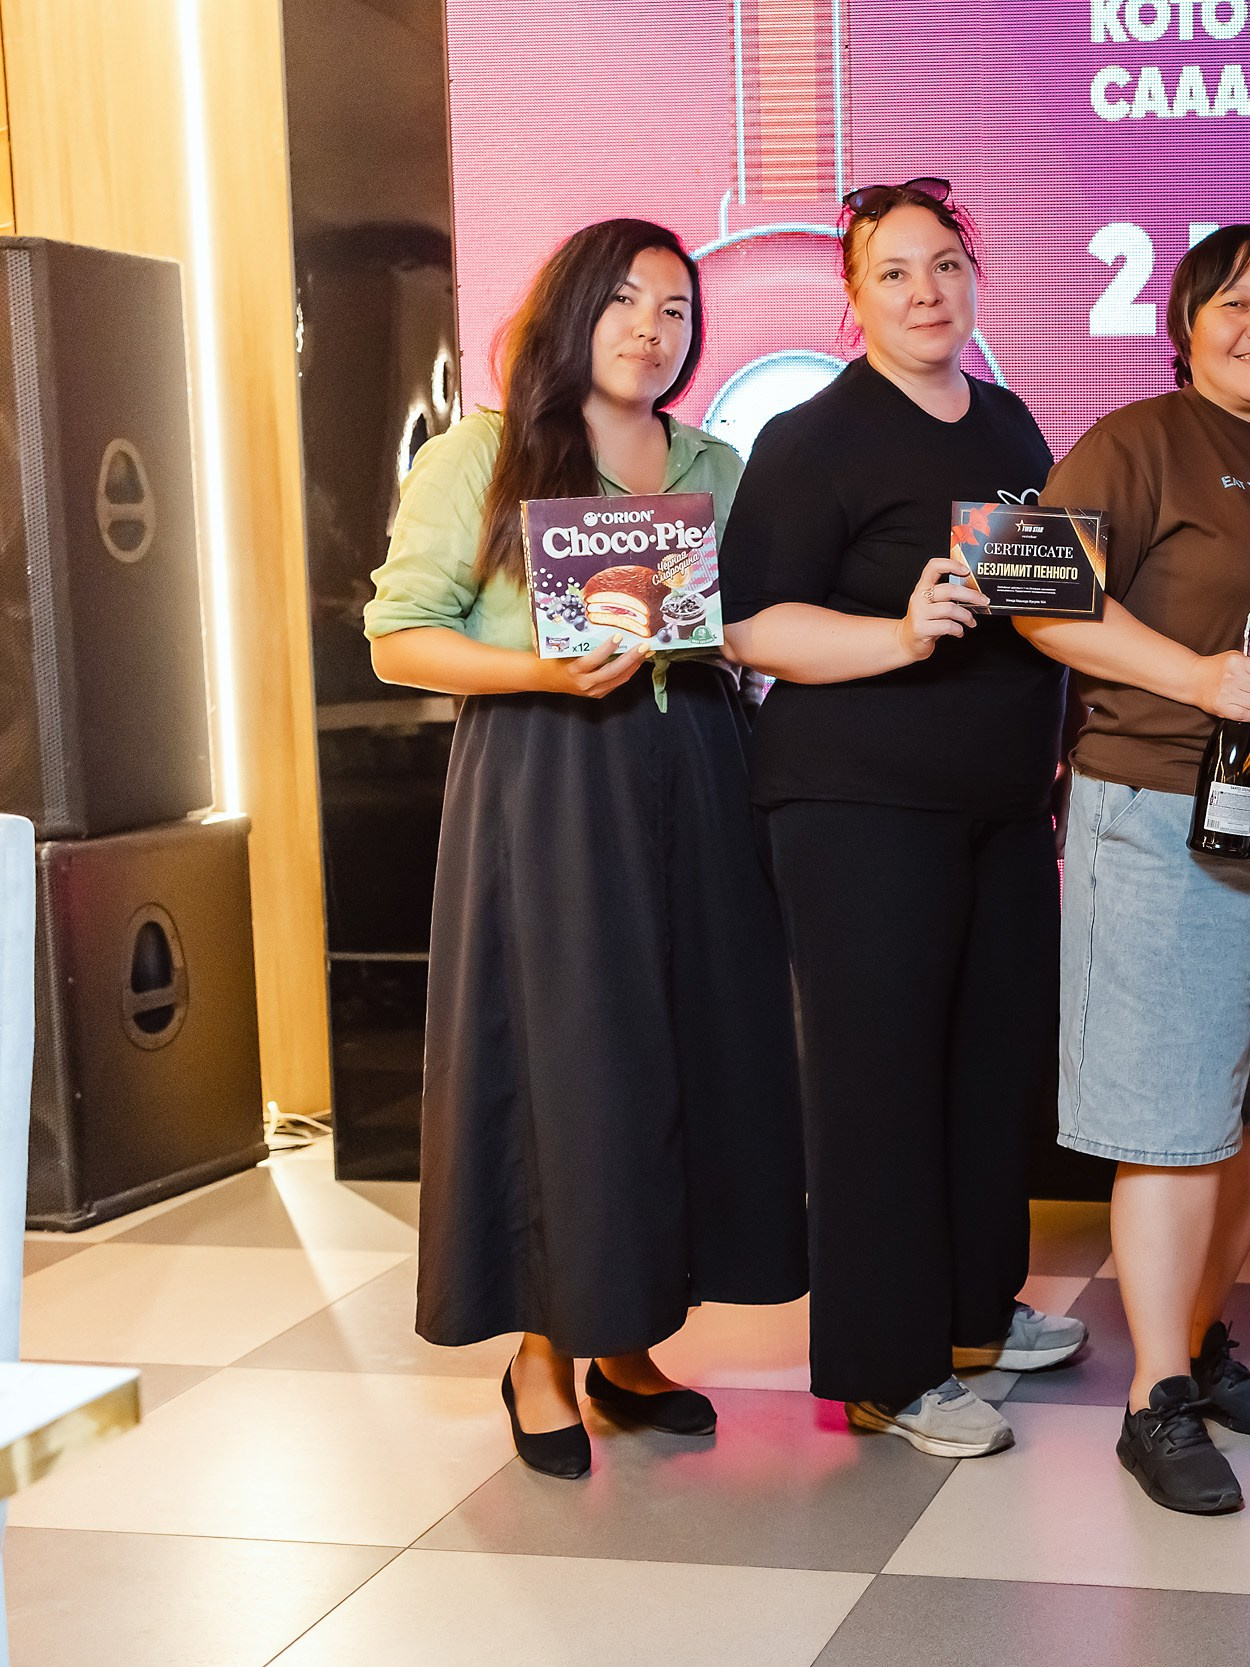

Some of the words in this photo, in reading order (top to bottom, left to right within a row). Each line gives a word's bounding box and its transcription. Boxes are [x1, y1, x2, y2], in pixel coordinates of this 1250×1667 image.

[1088, 222, 1157, 337] 2
[1221, 475, 1245, 490] EAT
[600, 510, 652, 525] ORION
[984, 542, 1074, 559] CERTIFICATE
[977, 562, 1032, 578] БЕЗЛИМИТ
[1033, 565, 1078, 580] ПЕННОГО
